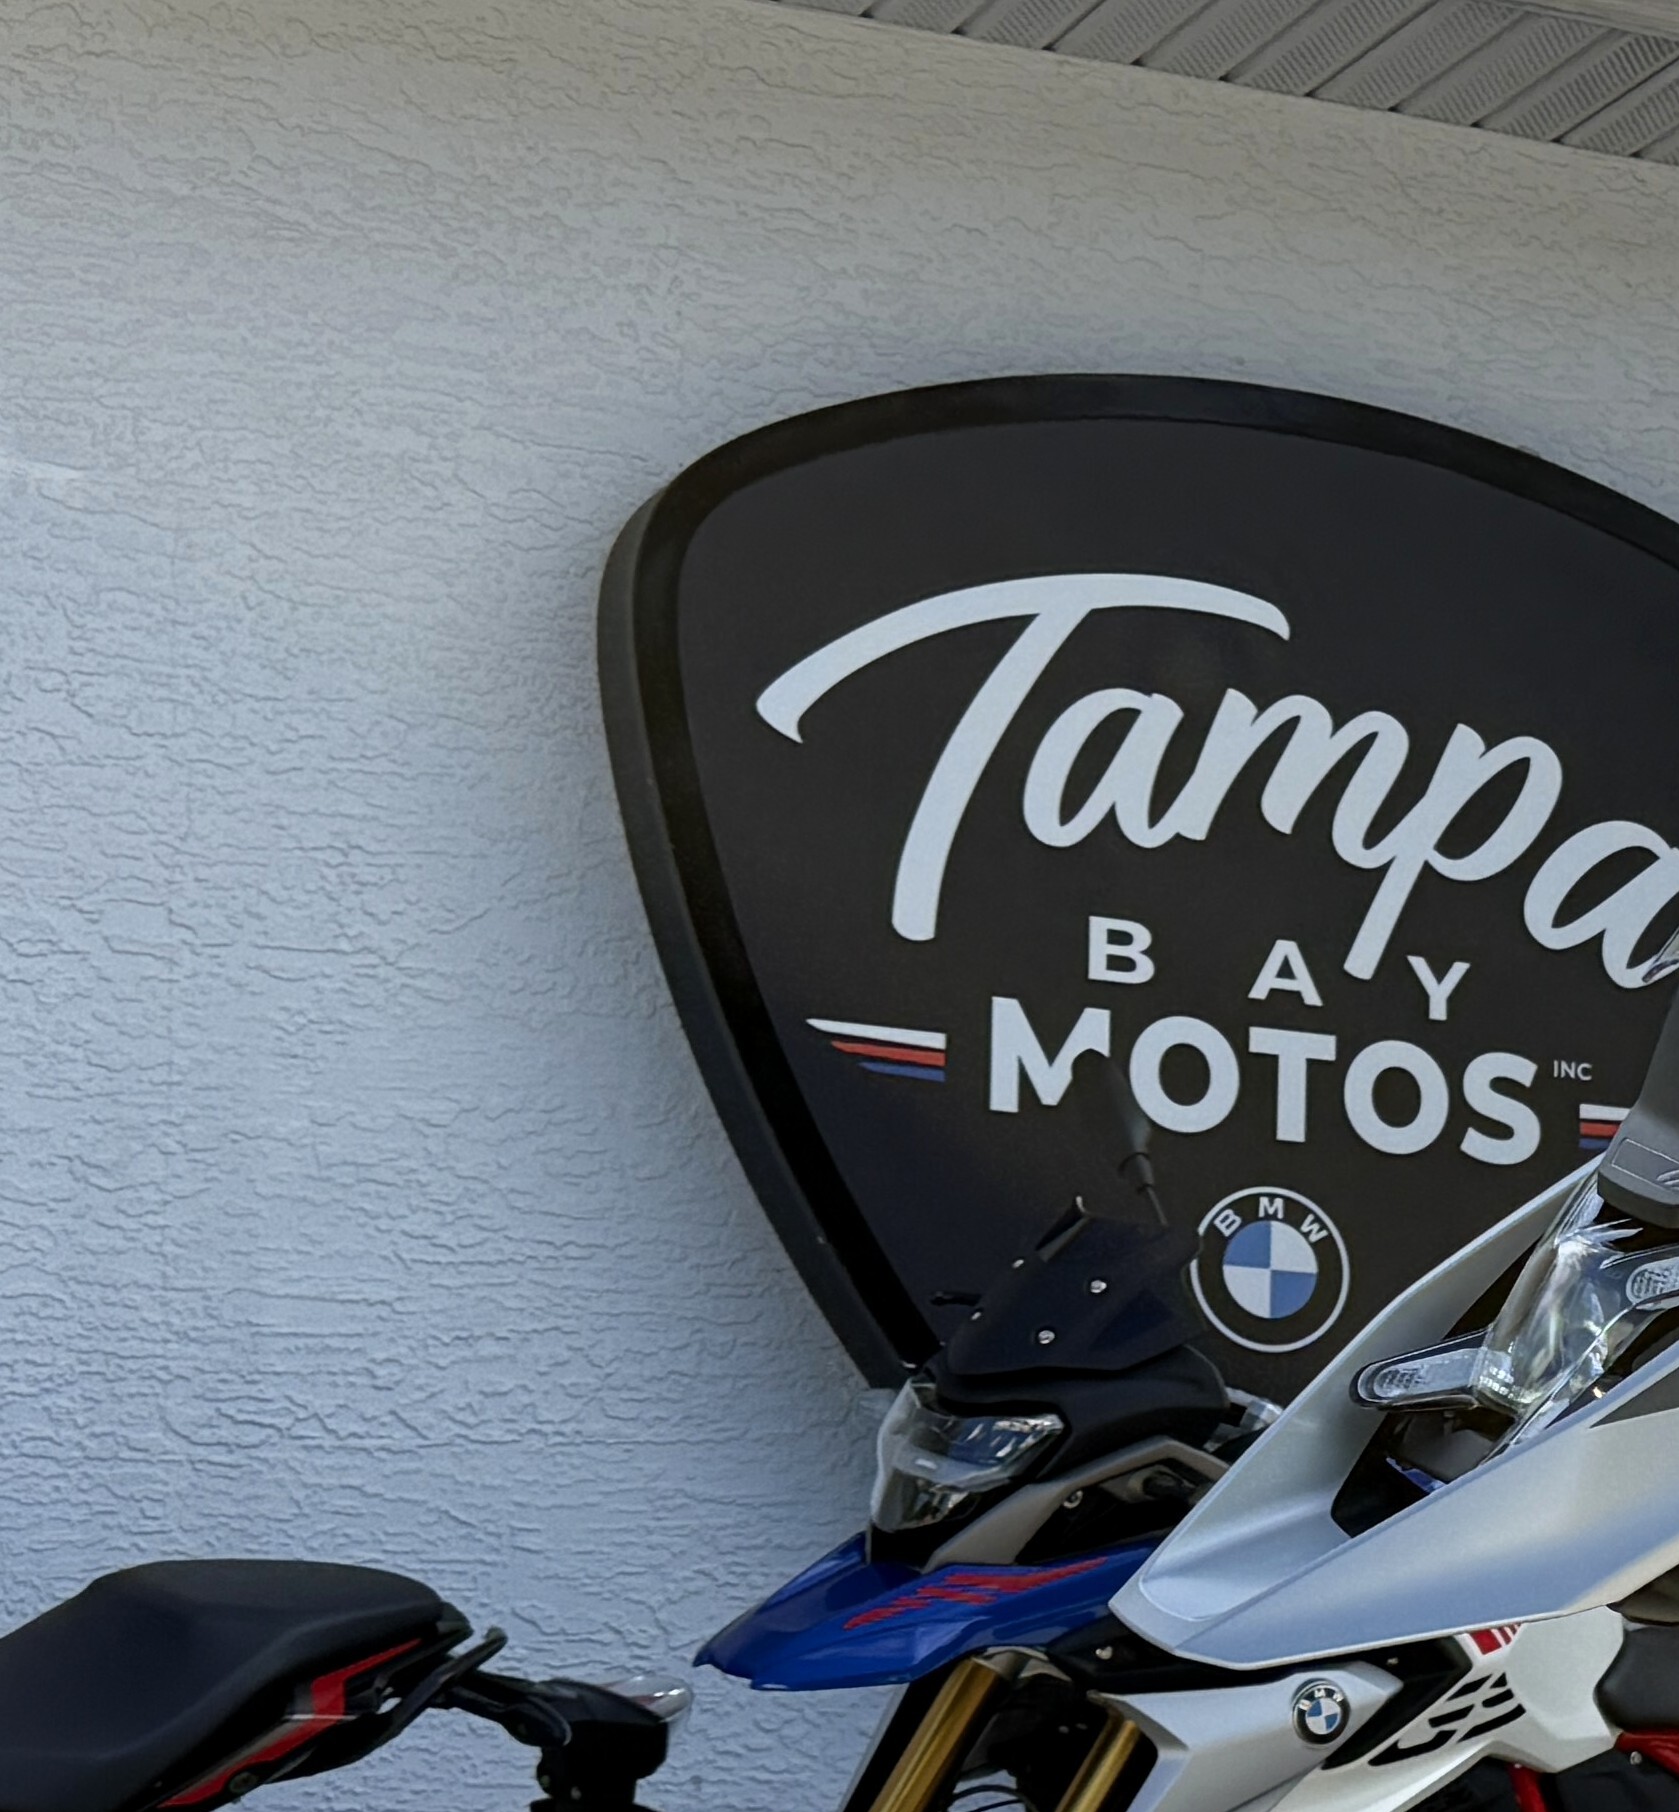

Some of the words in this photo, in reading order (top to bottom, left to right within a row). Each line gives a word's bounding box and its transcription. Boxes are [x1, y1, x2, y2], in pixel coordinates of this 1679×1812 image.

[988, 996, 1541, 1165] MOTOS
[1552, 1060, 1592, 1081] INC
[1213, 1196, 1330, 1243] BMW
